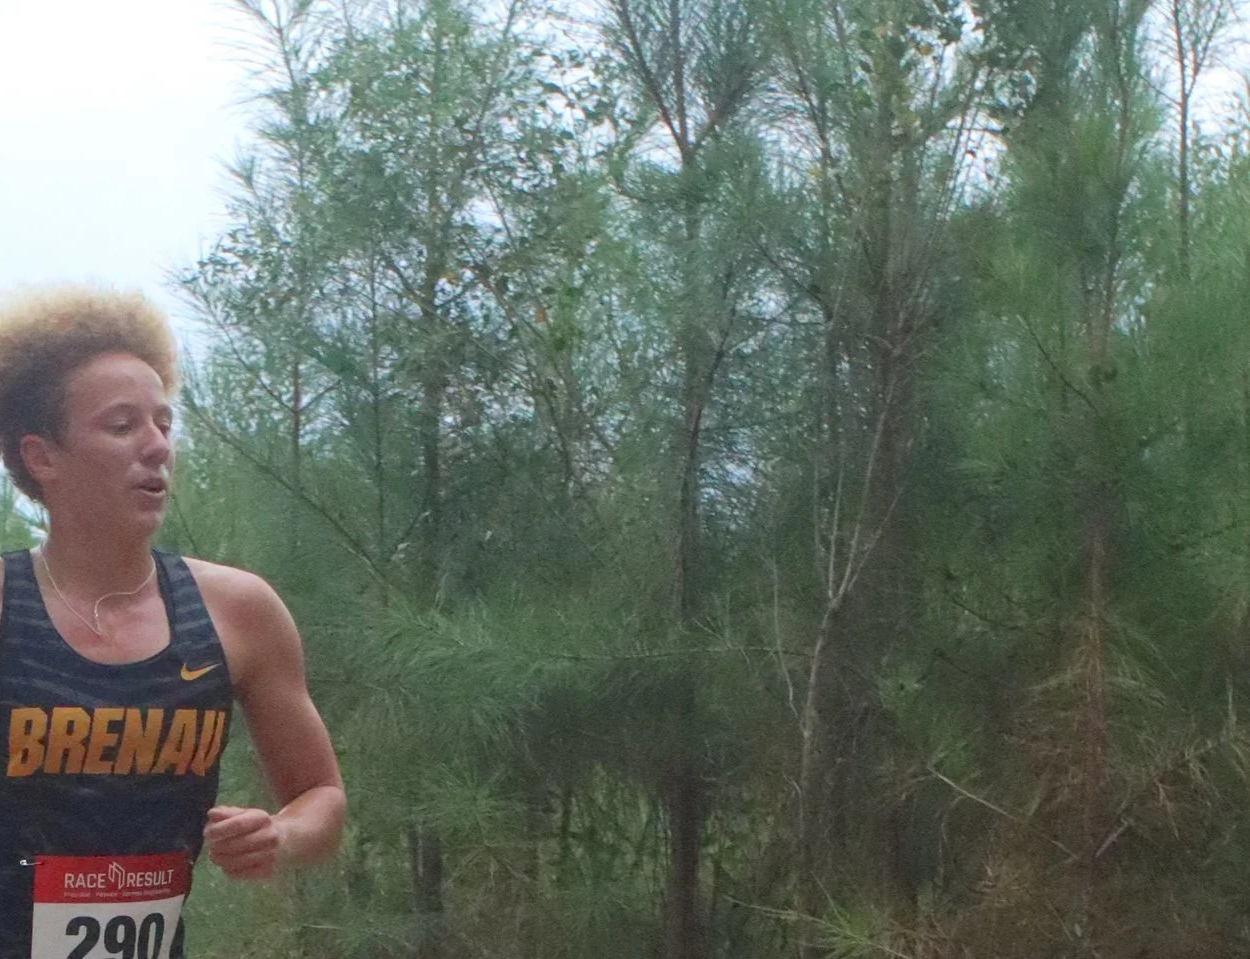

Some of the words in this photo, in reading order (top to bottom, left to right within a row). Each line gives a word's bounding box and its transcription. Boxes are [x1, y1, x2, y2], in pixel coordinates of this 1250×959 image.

[6, 706, 226, 777] BRENAU
[64, 873, 106, 889] RACE
[126, 869, 175, 888] RESULT
